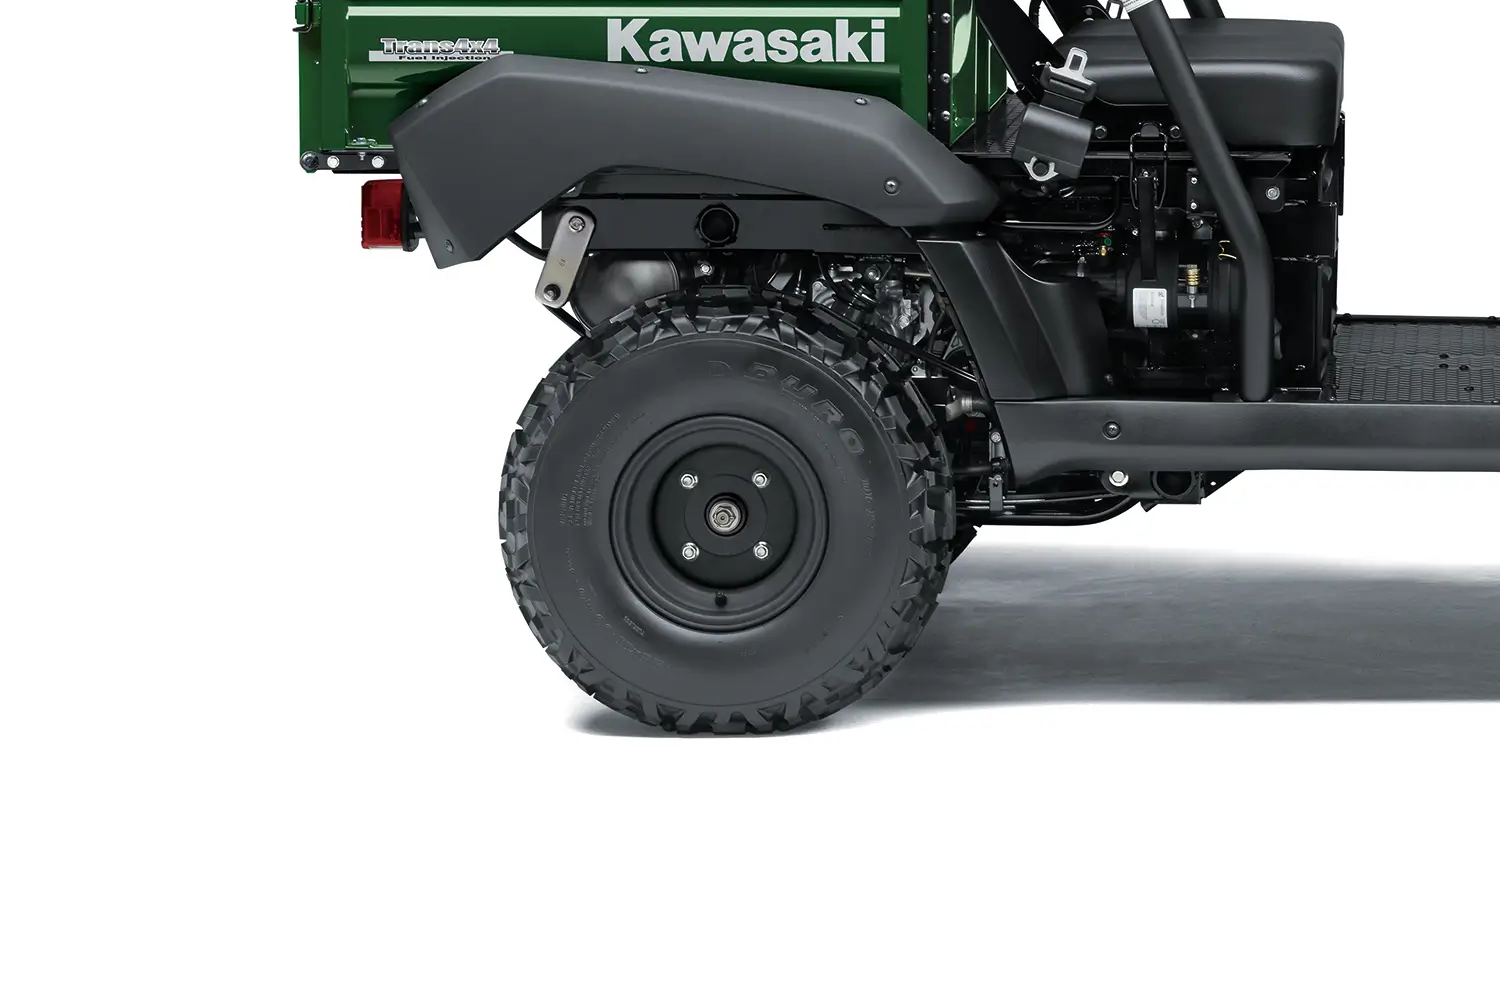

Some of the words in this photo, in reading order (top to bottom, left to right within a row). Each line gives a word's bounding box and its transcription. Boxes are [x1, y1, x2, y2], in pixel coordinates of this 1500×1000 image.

[380, 37, 501, 54] Trans4x4
[607, 18, 885, 63] Kawasaki
[744, 362, 865, 455] DURO
